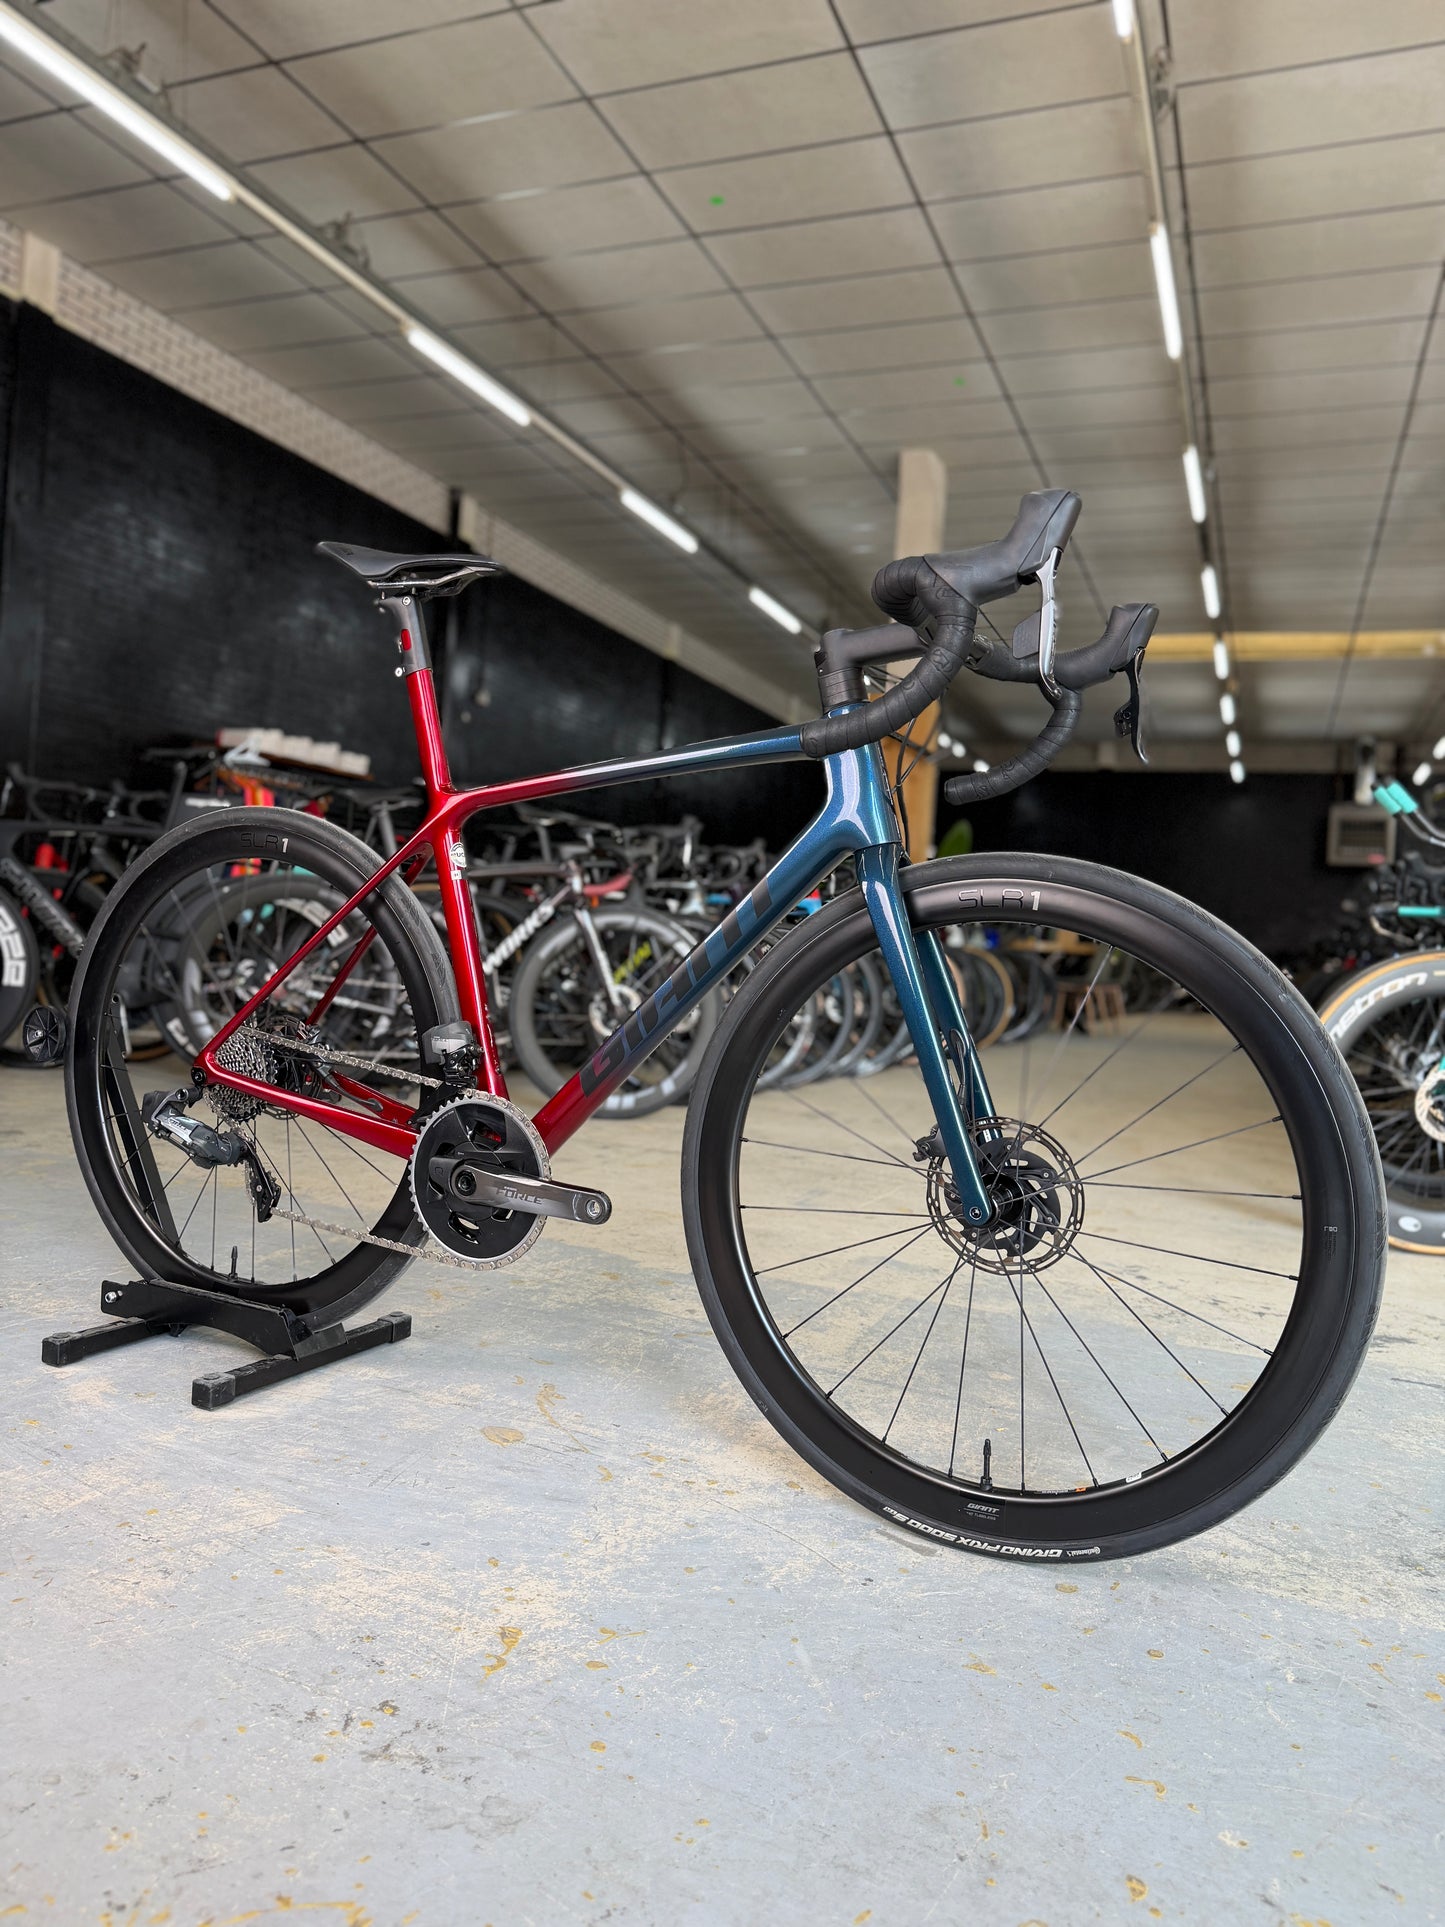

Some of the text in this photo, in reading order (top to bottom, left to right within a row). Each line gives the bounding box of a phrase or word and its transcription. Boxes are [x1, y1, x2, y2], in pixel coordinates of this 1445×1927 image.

[578, 876, 772, 1098] GIANT
[496, 1187, 543, 1205] FORCE
[967, 1503, 1000, 1513] GIANT
[906, 1519, 958, 1542] 5000
[959, 1536, 1000, 1553] PRIX
[1000, 1545, 1063, 1558] GRAND
